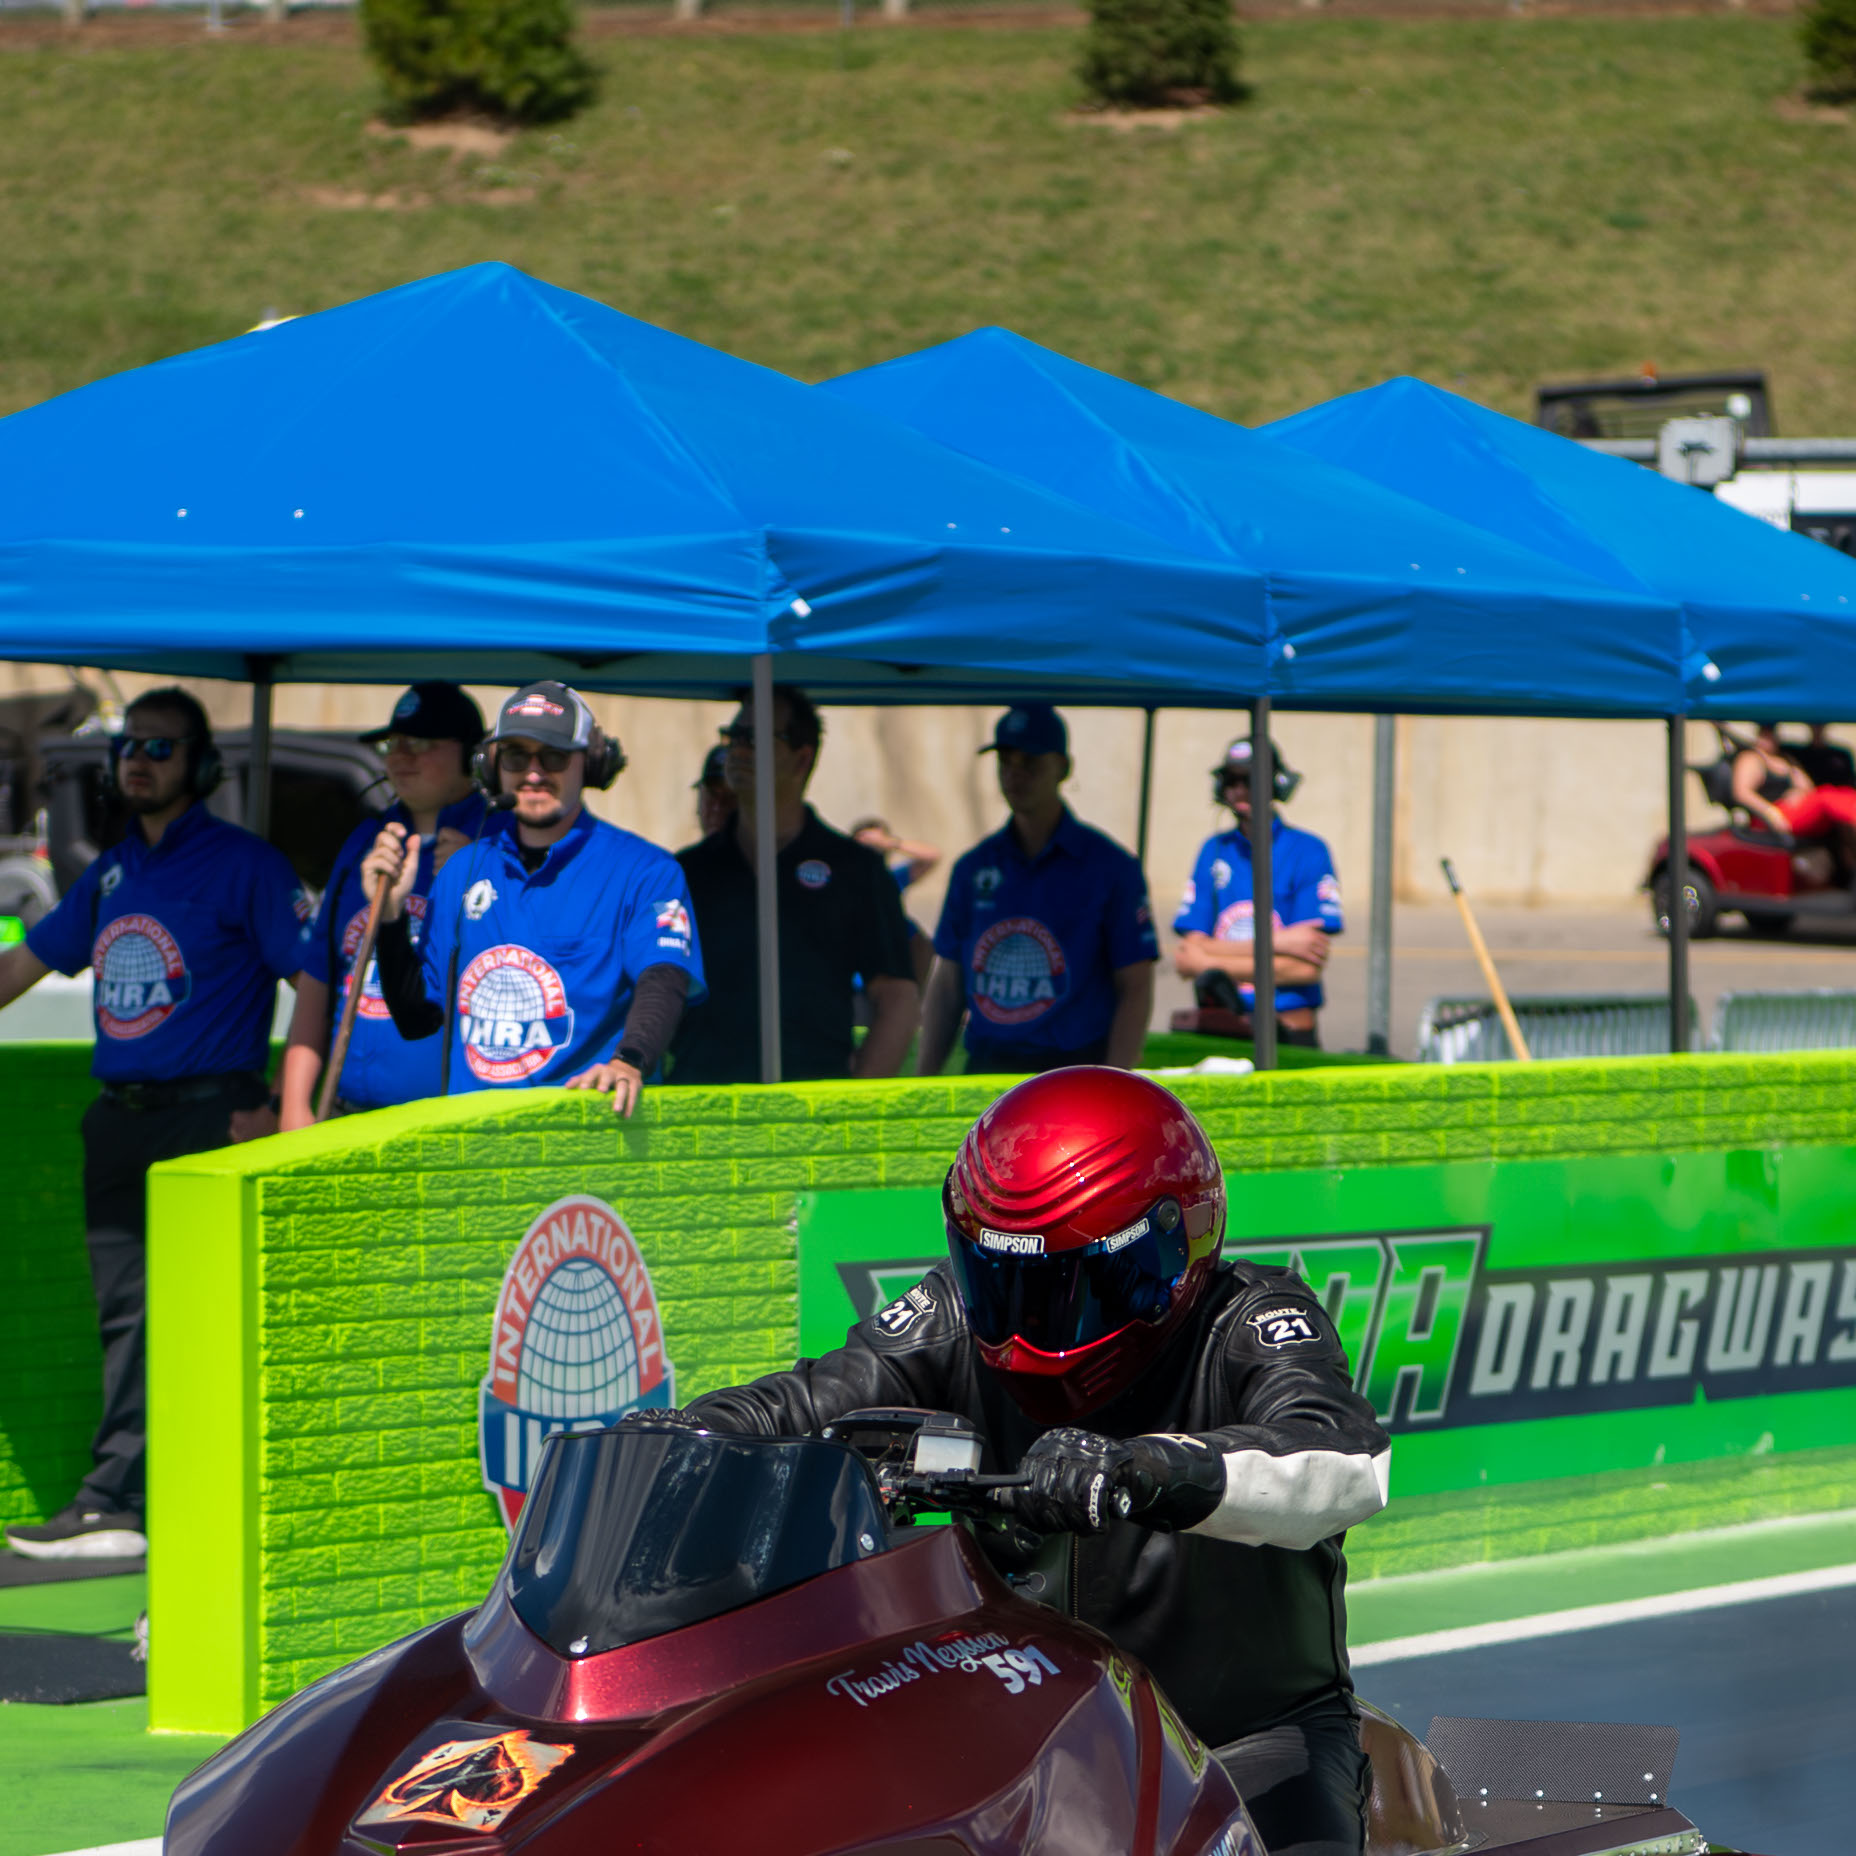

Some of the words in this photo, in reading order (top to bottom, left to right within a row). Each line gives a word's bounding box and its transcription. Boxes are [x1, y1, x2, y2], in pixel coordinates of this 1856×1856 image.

[459, 949, 563, 1012] INTERNATIONAL
[976, 972, 1055, 999] IHRA
[460, 1015, 553, 1048] IHRA
[983, 1231, 1040, 1254] SIMPSON
[1109, 1220, 1147, 1250] SIMPSON
[496, 1207, 661, 1384] INTERNATIONAL
[880, 1300, 914, 1330] 21
[1255, 1307, 1300, 1322] ROUTE
[1267, 1318, 1312, 1342] 21
[826, 1661, 921, 1707] Travis
[980, 1644, 1062, 1694] 591
